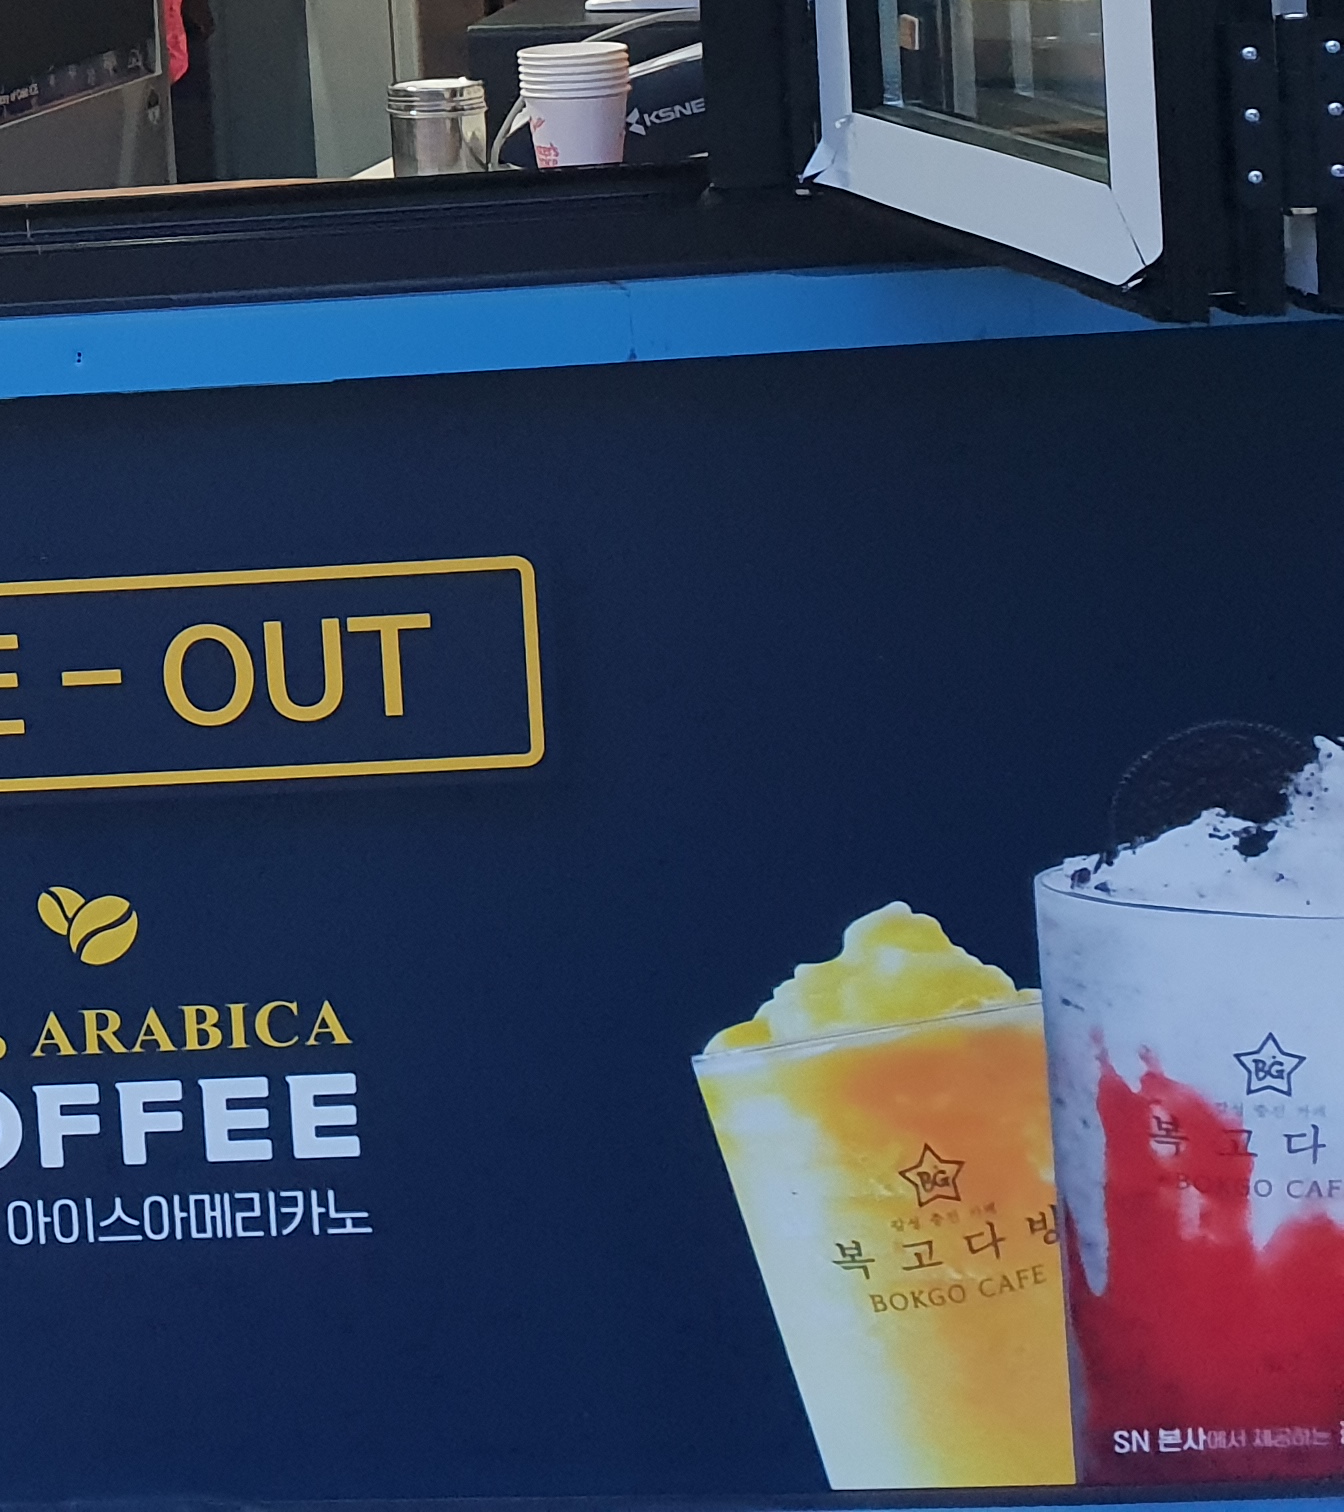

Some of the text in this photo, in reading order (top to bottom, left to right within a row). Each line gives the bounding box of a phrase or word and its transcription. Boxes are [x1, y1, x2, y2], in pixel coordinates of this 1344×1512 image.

[162, 612, 432, 727] OUT
[32, 998, 353, 1060] ARABICA
[1251, 1055, 1286, 1082] BG
[916, 1165, 950, 1192] BG
[7, 1187, 374, 1248] 아이스아메리카노
[868, 1264, 1047, 1315] BOKGO CAFE
[1114, 1430, 1149, 1454] SN
[1158, 1427, 1246, 1453] 본사에서
